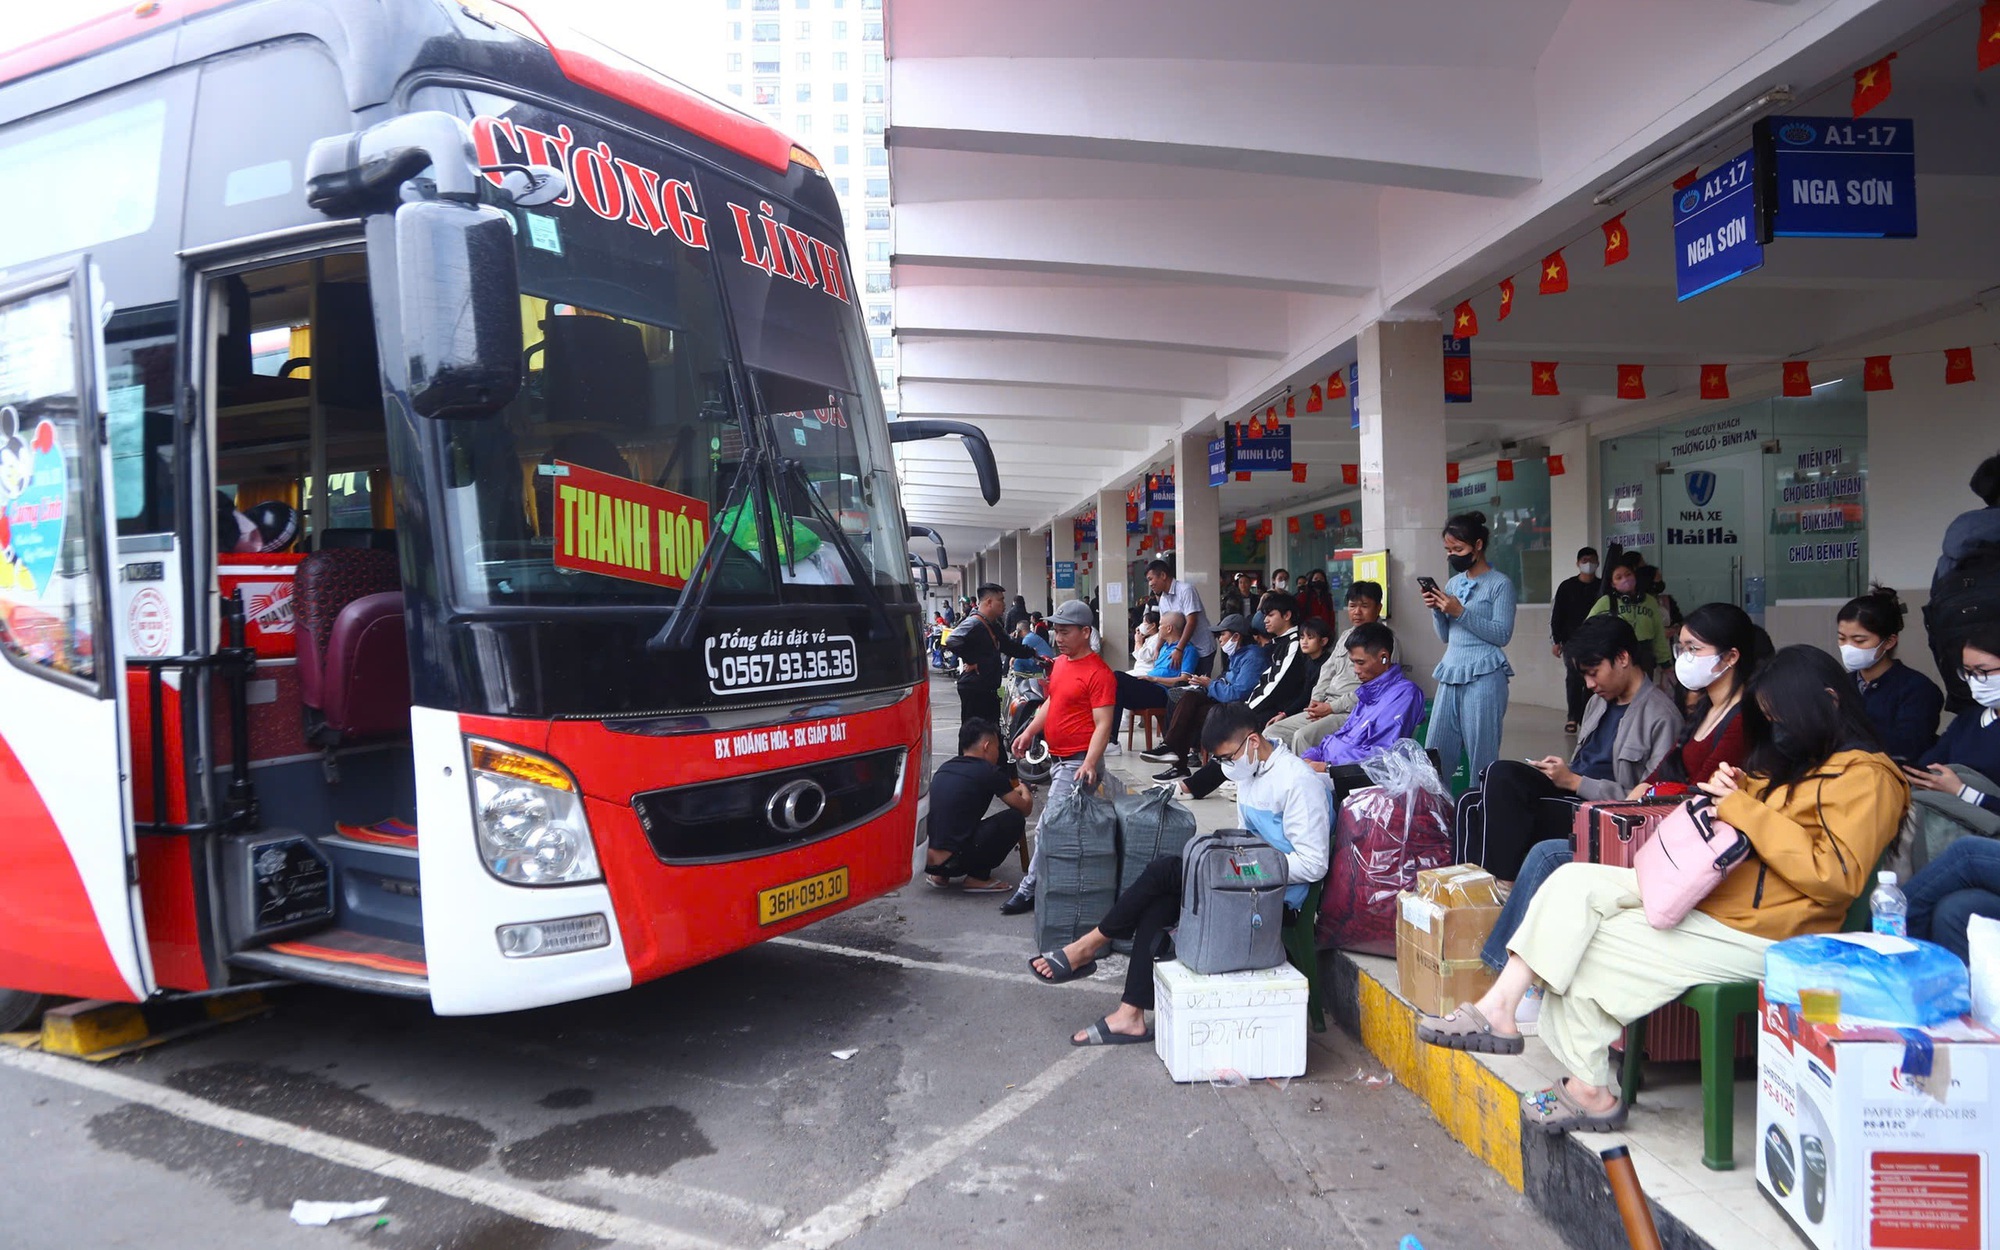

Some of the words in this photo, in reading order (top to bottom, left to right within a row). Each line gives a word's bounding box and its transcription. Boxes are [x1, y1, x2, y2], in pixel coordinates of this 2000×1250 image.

[1824, 126, 1896, 145] A1-17
[1704, 160, 1747, 202] A1-17
[1793, 179, 1840, 205] NGA
[1847, 178, 1893, 205] SƠN
[726, 201, 851, 306] LĨNH
[1687, 235, 1715, 267] NGA
[1717, 216, 1746, 251] SƠN
[1744, 428, 1758, 443] AN
[1237, 449, 1263, 460] MINH
[1266, 447, 1284, 462] LỘC
[1825, 444, 1842, 465] PHÍ
[1804, 480, 1829, 502] BỆNH
[1680, 508, 1704, 521] NHÀ
[1707, 511, 1722, 521] XE
[560, 484, 651, 572] THANH
[1817, 541, 1842, 564] BỆNH
[720, 627, 758, 651] Tổng
[761, 628, 783, 647] đài
[787, 628, 808, 648] đặt
[812, 628, 826, 644] vé
[722, 649, 852, 686] 0567.93.36.36
[714, 738, 731, 759] BX
[770, 726, 789, 750] HÓA
[794, 728, 807, 747] BX
[807, 721, 828, 745] GIÁP
[830, 718, 847, 742] BÁT
[768, 875, 842, 916] 36H-093.30
